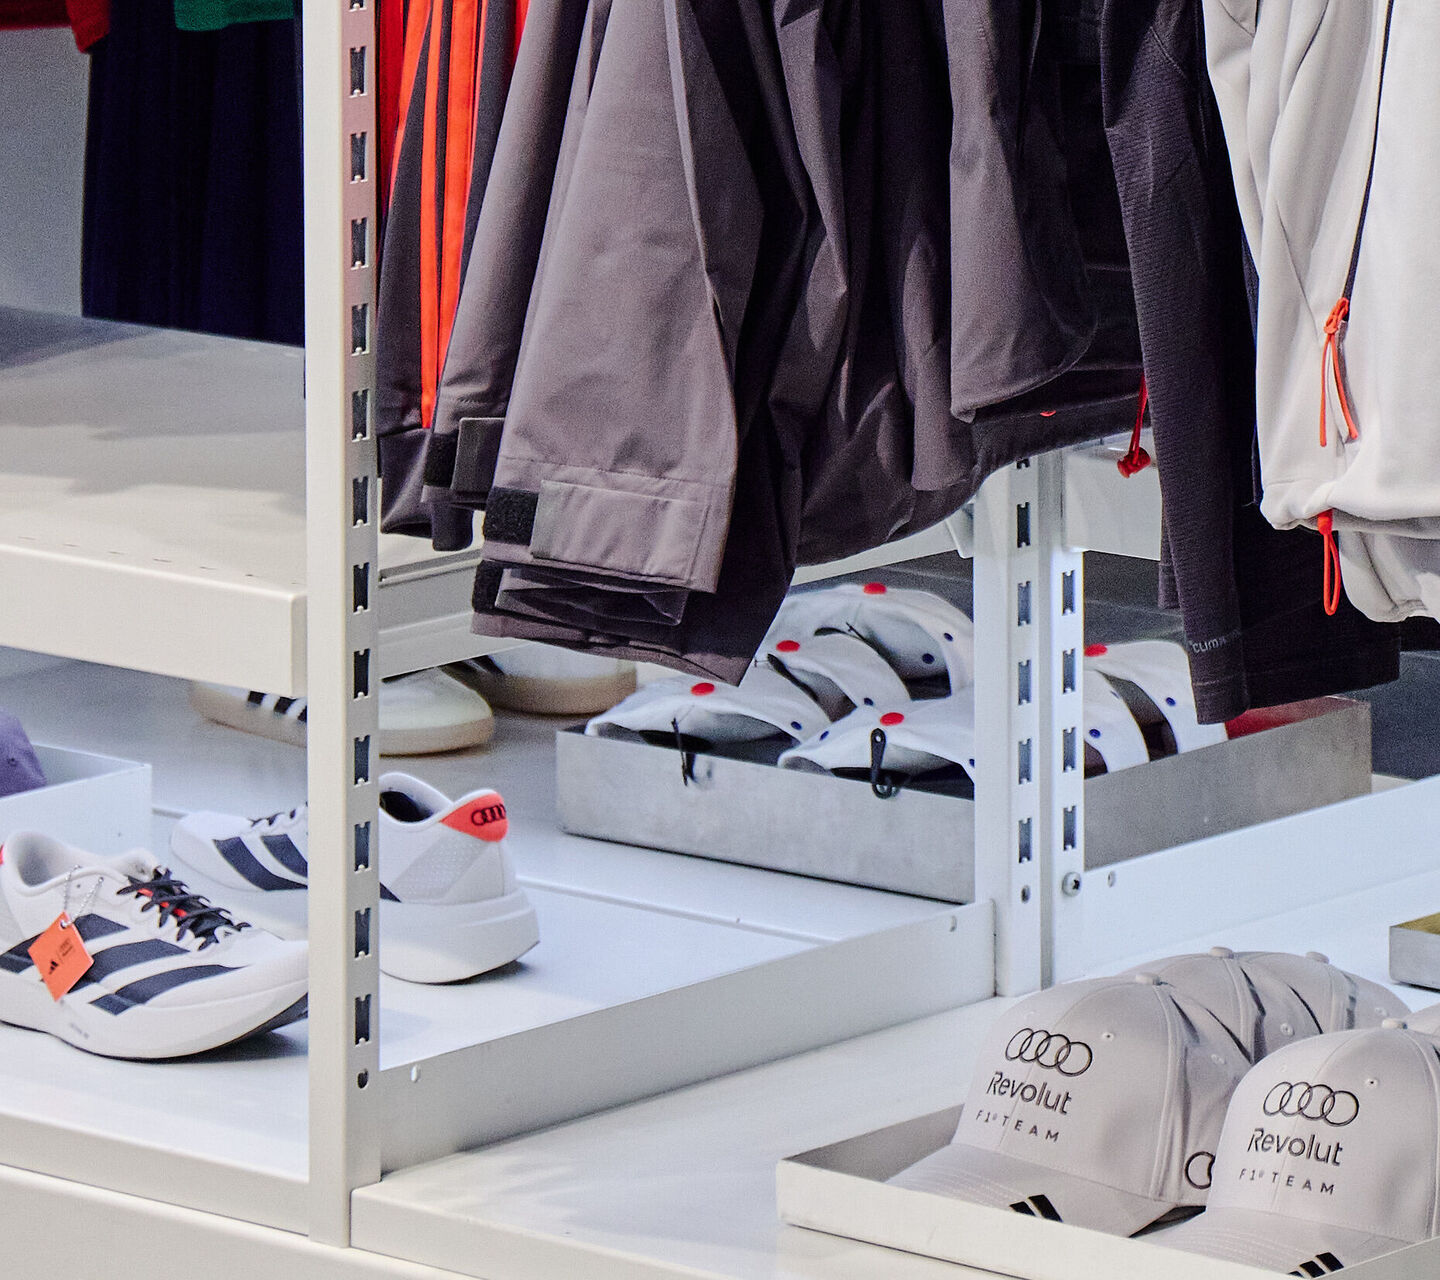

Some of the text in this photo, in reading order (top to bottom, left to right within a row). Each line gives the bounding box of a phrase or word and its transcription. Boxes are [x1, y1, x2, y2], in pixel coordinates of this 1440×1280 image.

[985, 1070, 1072, 1115] Revolut
[1002, 1115, 1060, 1143] TEAM
[1246, 1127, 1344, 1167] Revolut
[1272, 1171, 1335, 1196] TEAM
